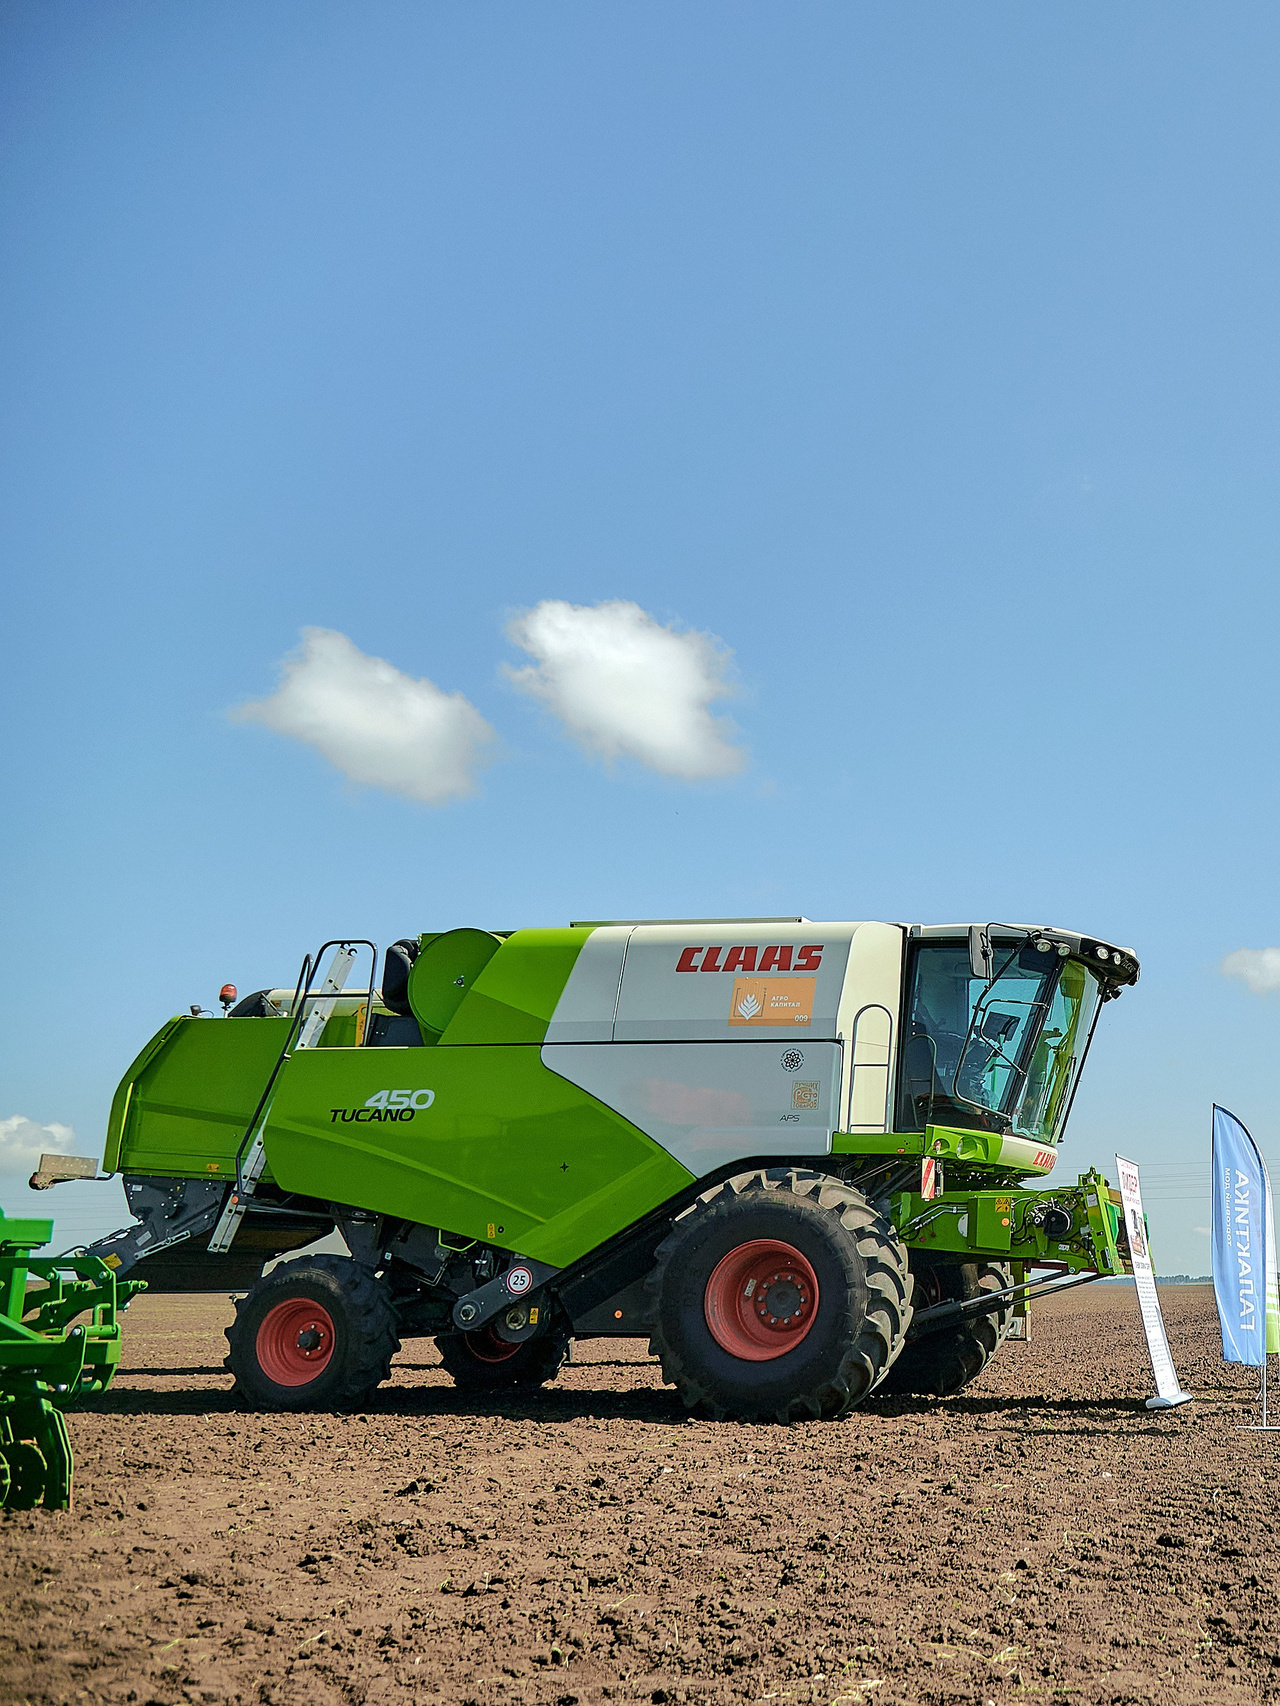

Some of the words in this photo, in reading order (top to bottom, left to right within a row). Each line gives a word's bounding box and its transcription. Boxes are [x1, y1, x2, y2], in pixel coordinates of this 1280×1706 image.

[675, 944, 825, 973] CLAAS
[794, 1014, 809, 1022] 009
[364, 1089, 435, 1110] 450
[330, 1108, 416, 1123] TUCANO
[779, 1114, 801, 1123] APS
[512, 1275, 526, 1286] 25
